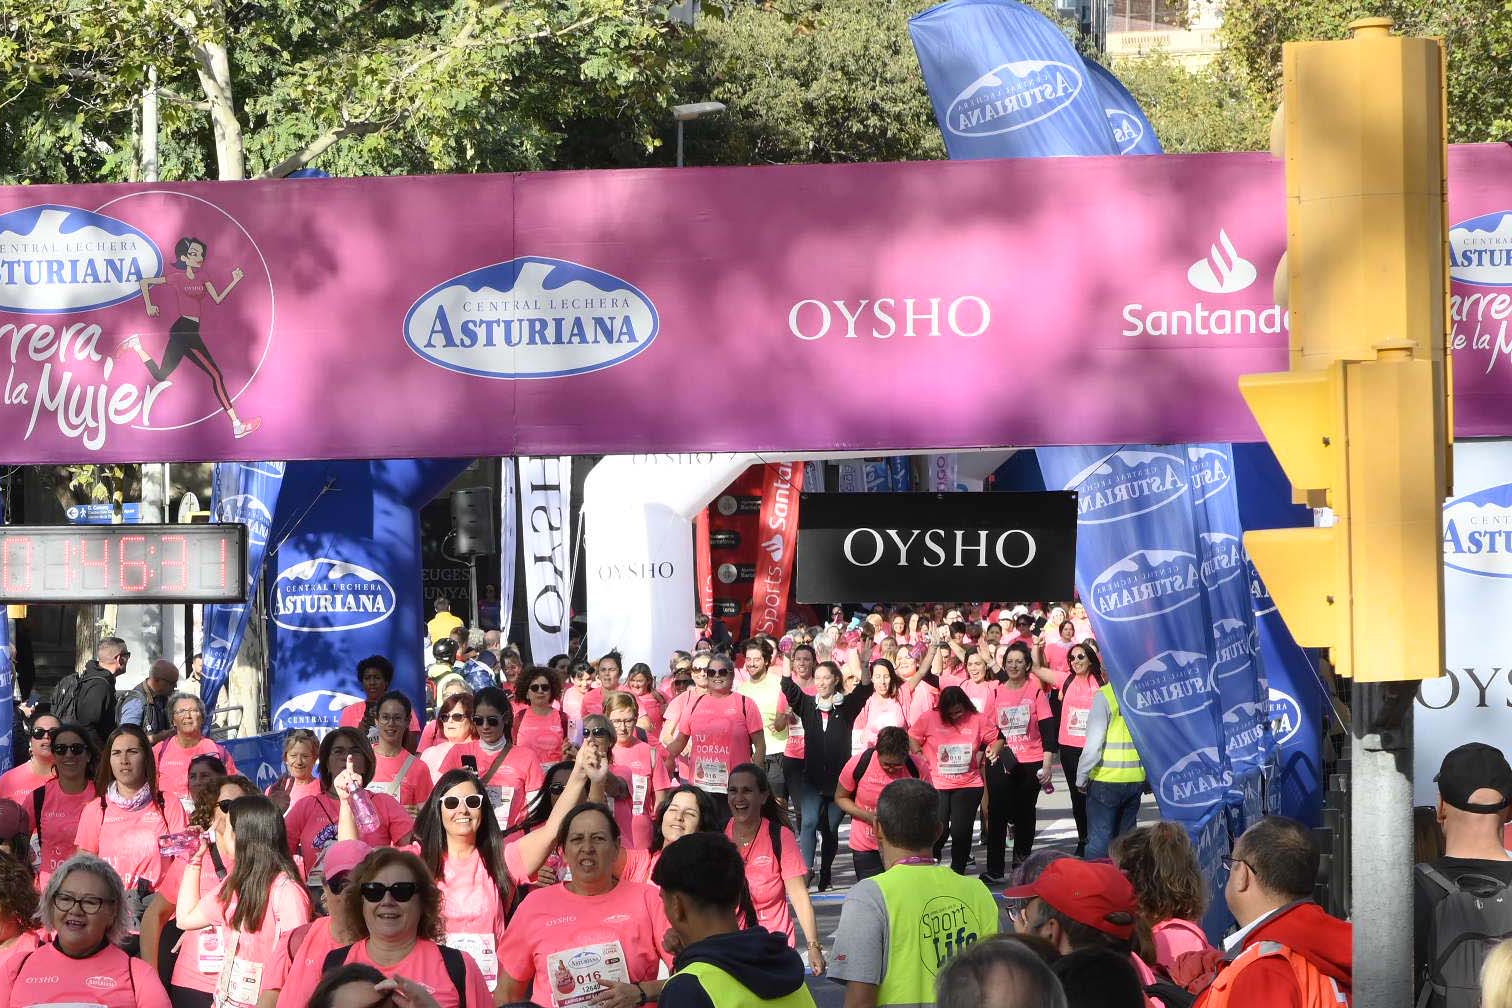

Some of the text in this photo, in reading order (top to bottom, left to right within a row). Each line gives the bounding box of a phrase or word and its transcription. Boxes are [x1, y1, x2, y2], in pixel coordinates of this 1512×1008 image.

[66, 240, 138, 253] LECHERA
[463, 298, 631, 313] CENTRAL LECHERA
[788, 295, 992, 342] OYSHO
[1451, 292, 1512, 322] arre
[424, 304, 639, 348] ASTURIANA
[4, 366, 30, 406] la
[24, 357, 173, 451] Mujer
[756, 461, 793, 635] Sports Santa
[843, 527, 1037, 569] OYSHO
[598, 561, 675, 582] OYSHO
[275, 588, 386, 616] ASTURIANA
[286, 583, 382, 593] CENTRAL LECHERA
[696, 744, 729, 755] DORSAL
[922, 905, 968, 939] Sport
[576, 970, 602, 984] 016
